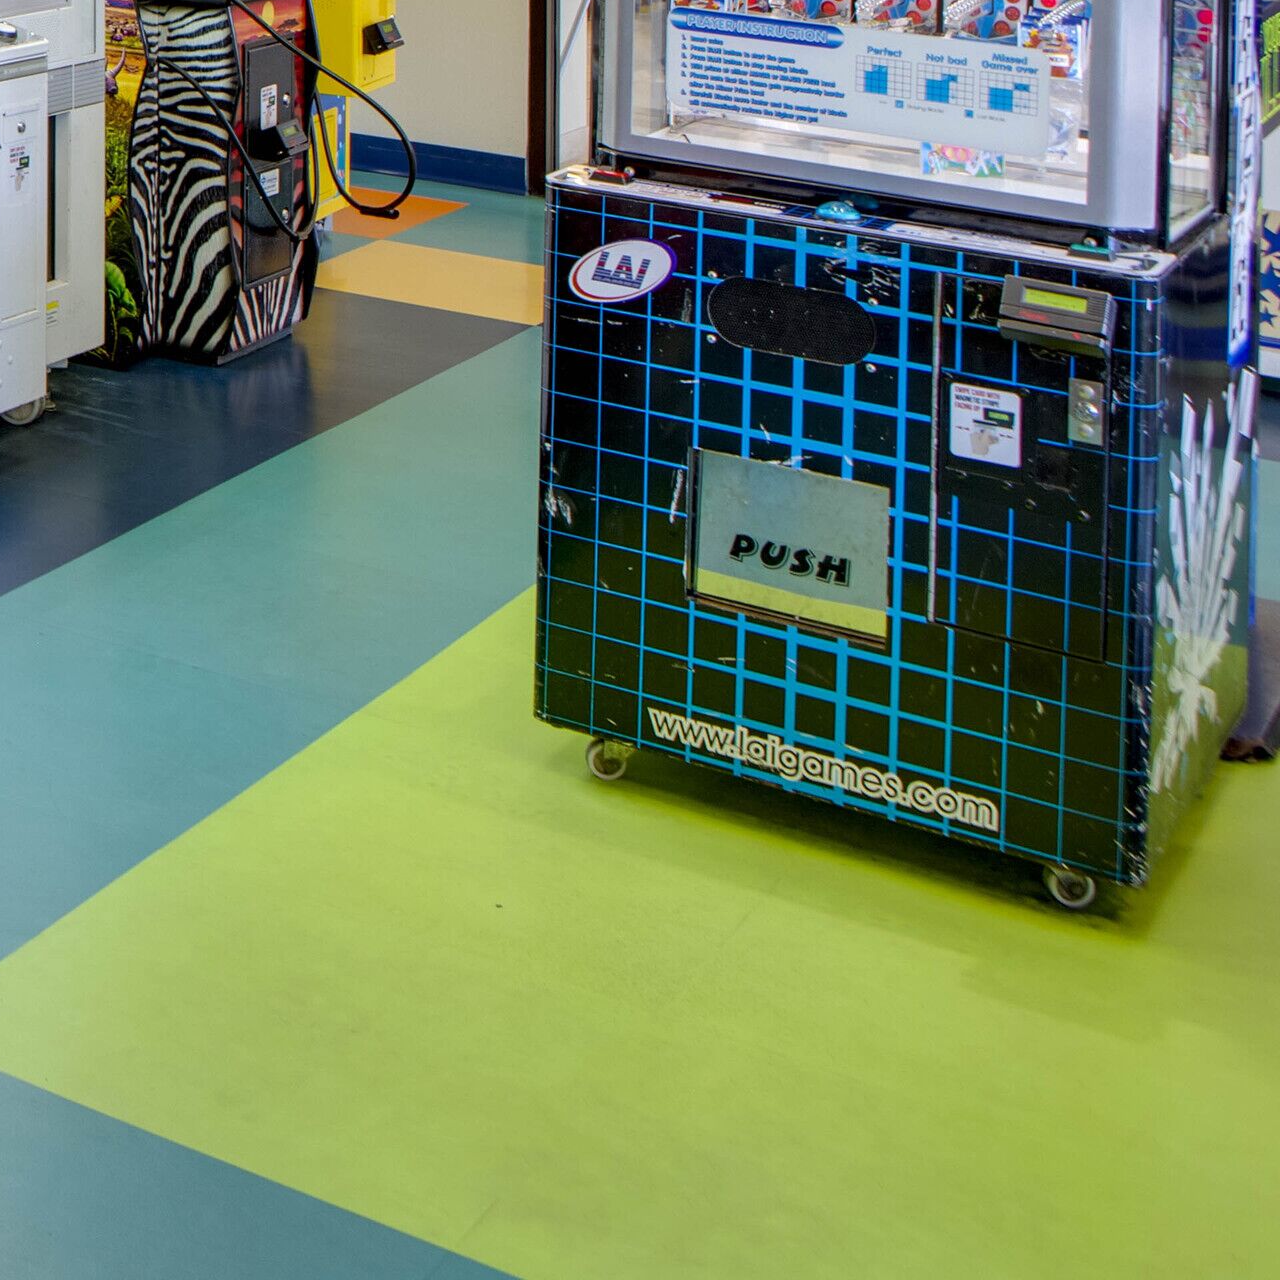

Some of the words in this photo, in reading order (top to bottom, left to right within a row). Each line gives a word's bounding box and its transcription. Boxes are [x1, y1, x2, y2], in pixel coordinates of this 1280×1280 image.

[687, 14, 735, 32] PLAYER
[736, 21, 828, 44] INSTRUCTION
[867, 45, 903, 58] Perfect
[926, 53, 944, 64] Not
[947, 55, 968, 66] bad
[992, 53, 1028, 66] Missed
[982, 61, 1012, 73] Game
[592, 251, 651, 288] LAI
[729, 532, 851, 587] PUSH
[647, 706, 1000, 832] www.laigames.com
